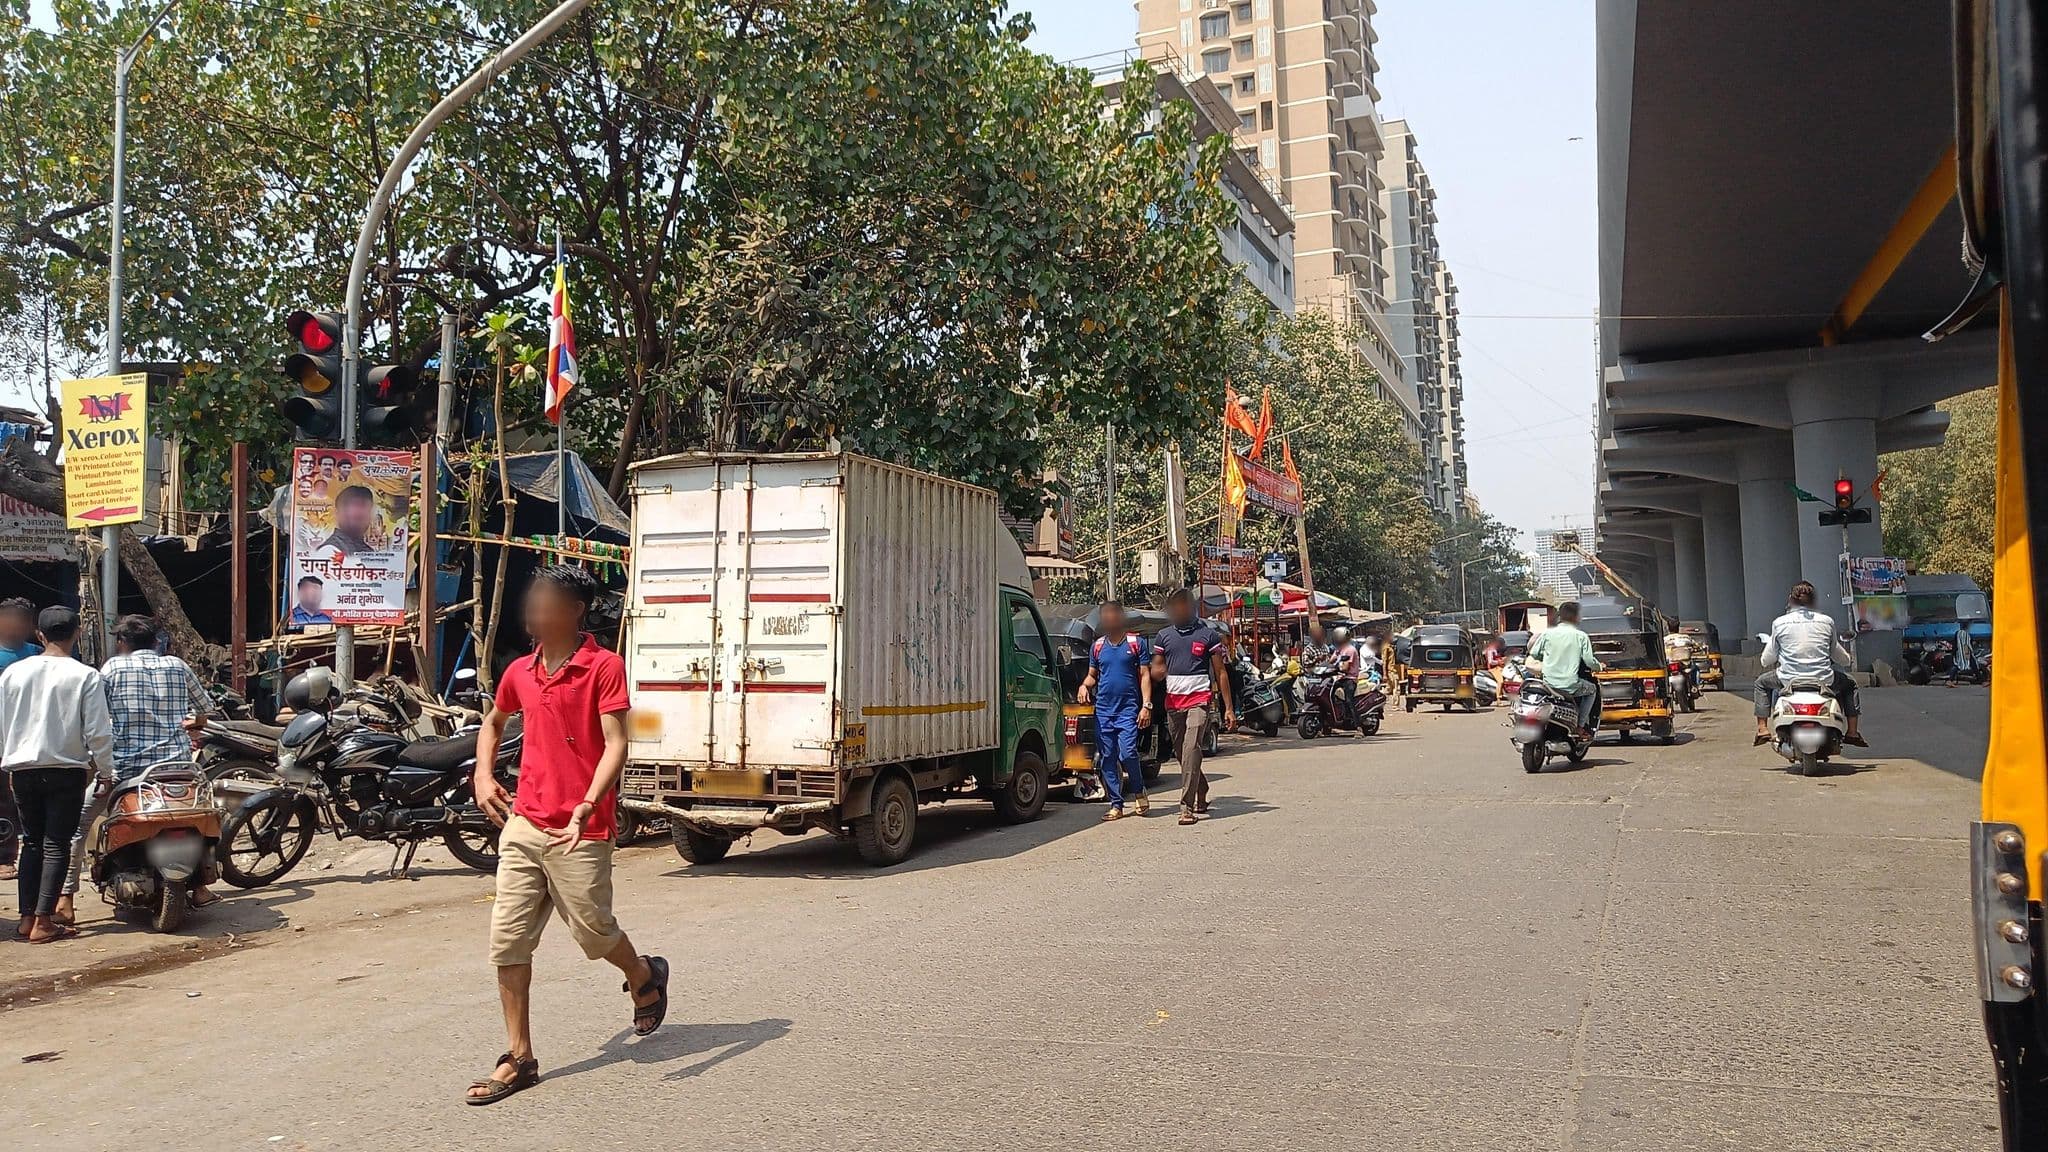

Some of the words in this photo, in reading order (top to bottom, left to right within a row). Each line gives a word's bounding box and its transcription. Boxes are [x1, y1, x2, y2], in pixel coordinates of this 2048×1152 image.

[67, 427, 140, 451] Xerox
[123, 467, 139, 475] Print
[393, 526, 405, 544] ५
[299, 558, 333, 580] राजू
[336, 593, 358, 605] अनंत
[358, 592, 385, 607] शुभेच्छा
